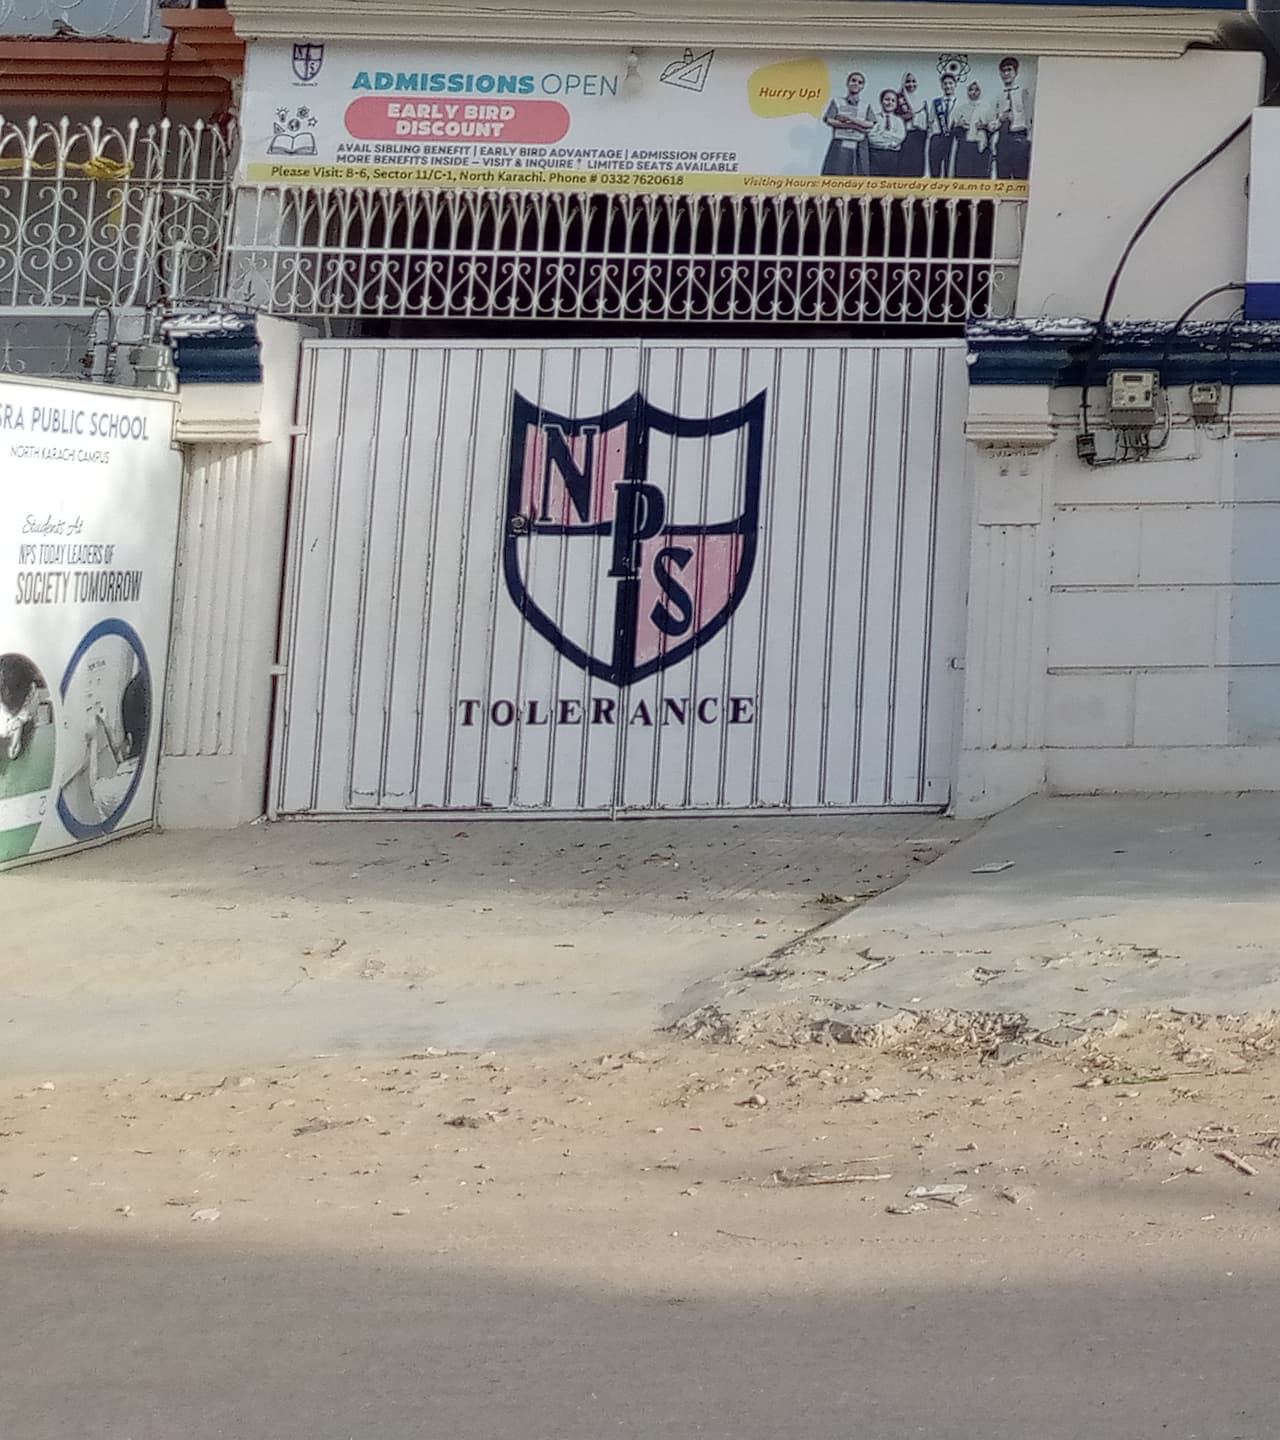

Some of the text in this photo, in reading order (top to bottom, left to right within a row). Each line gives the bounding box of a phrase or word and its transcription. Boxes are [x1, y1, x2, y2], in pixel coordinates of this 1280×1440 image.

[351, 71, 619, 96] ADMISSIONS OPEN
[758, 86, 822, 101] Hurry Up!
[386, 102, 516, 121] EARLY BIRD
[395, 120, 505, 138] DISCOUNT
[336, 143, 737, 162] AVAIL SIBLING BENEFIT EARLY BIRD ADVANTAGE ADMISSION OFFER
[271, 166, 310, 178] Please
[313, 166, 344, 180] Visit:
[372, 169, 414, 181] Sector
[416, 170, 457, 183] 11/C-1,
[459, 171, 495, 183] North
[497, 171, 546, 184] Karachi.
[549, 173, 588, 185] Phone
[589, 174, 598, 184] #
[600, 174, 630, 185] 0332
[632, 175, 684, 186] 7620618
[31, 406, 150, 441] PUBLIC SCHOOL
[535, 424, 694, 637] NPS
[67, 543, 103, 565] LEADERS
[15, 569, 144, 605] SOCIETY TOMORROW
[458, 697, 755, 727] TOLERANCE
